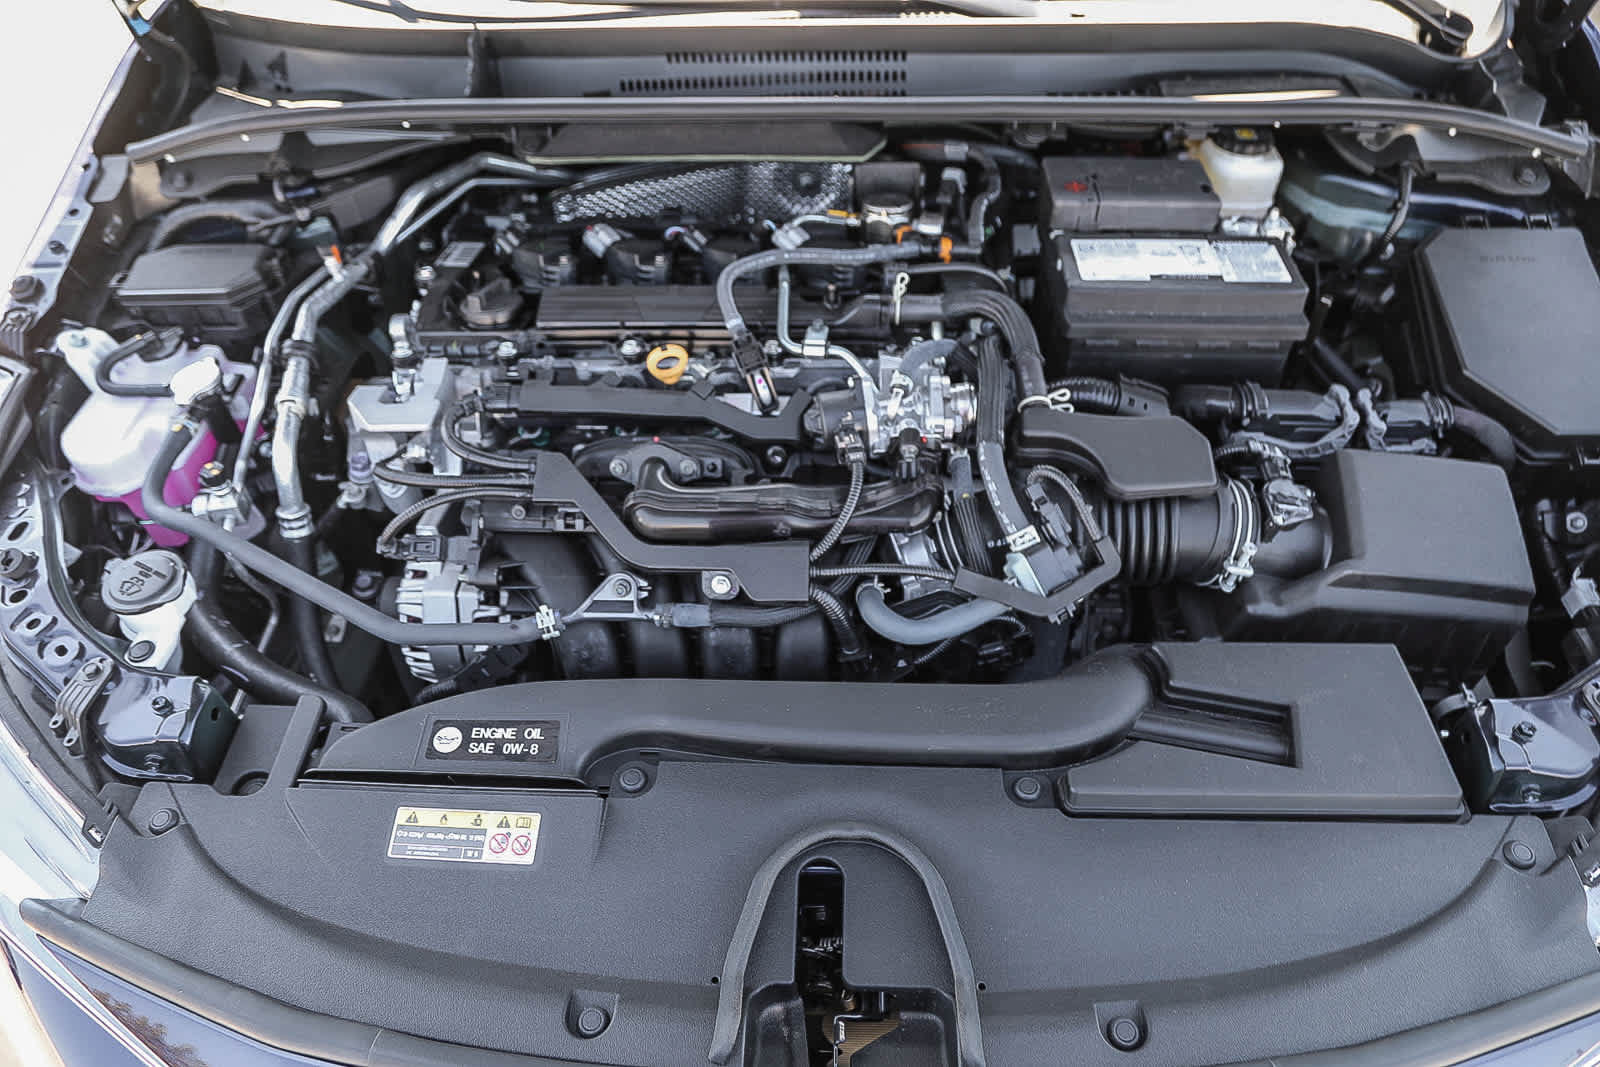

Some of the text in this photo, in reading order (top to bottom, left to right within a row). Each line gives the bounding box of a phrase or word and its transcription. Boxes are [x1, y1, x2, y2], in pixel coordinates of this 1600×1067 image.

[471, 727, 545, 740] ENGINE OIL
[468, 742, 539, 755] SAE 0W-8
